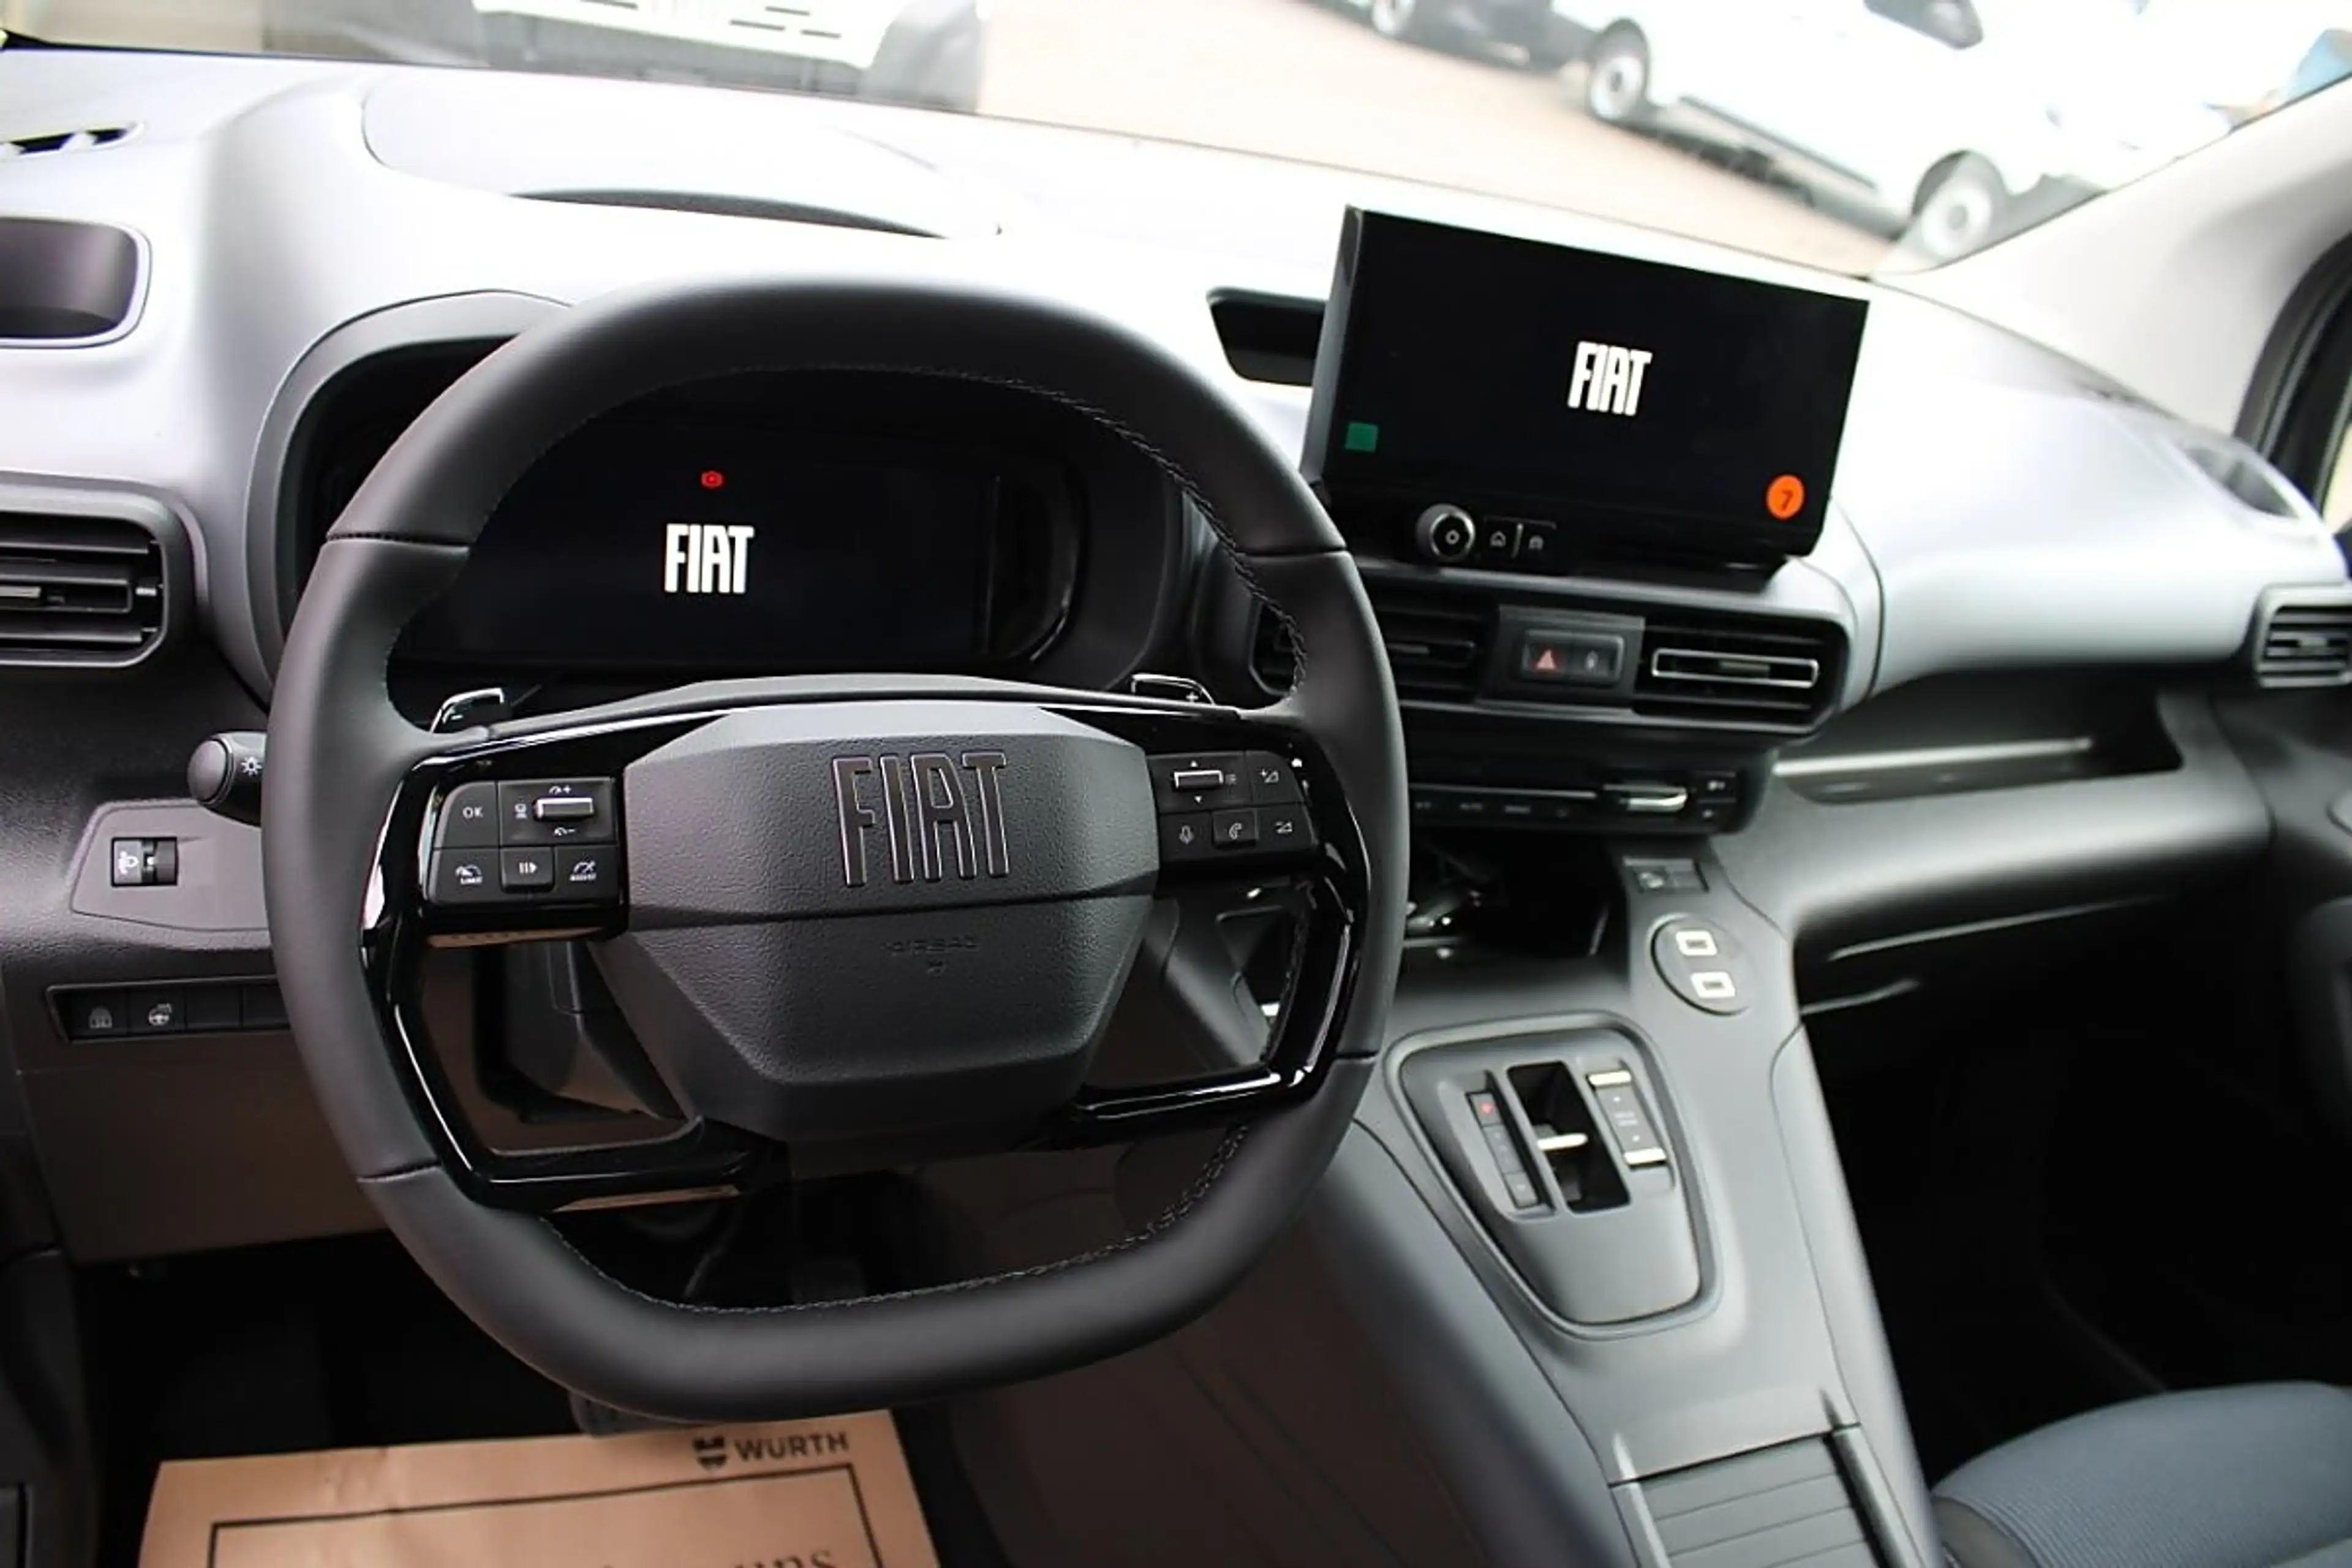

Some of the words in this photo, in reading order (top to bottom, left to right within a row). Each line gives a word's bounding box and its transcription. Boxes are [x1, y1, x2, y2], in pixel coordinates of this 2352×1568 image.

[1567, 341, 1653, 417] FIAT
[1781, 489, 1794, 512] 7
[665, 523, 755, 594] FIAT
[462, 806, 483, 819] OK
[832, 752, 1009, 886] FIAT
